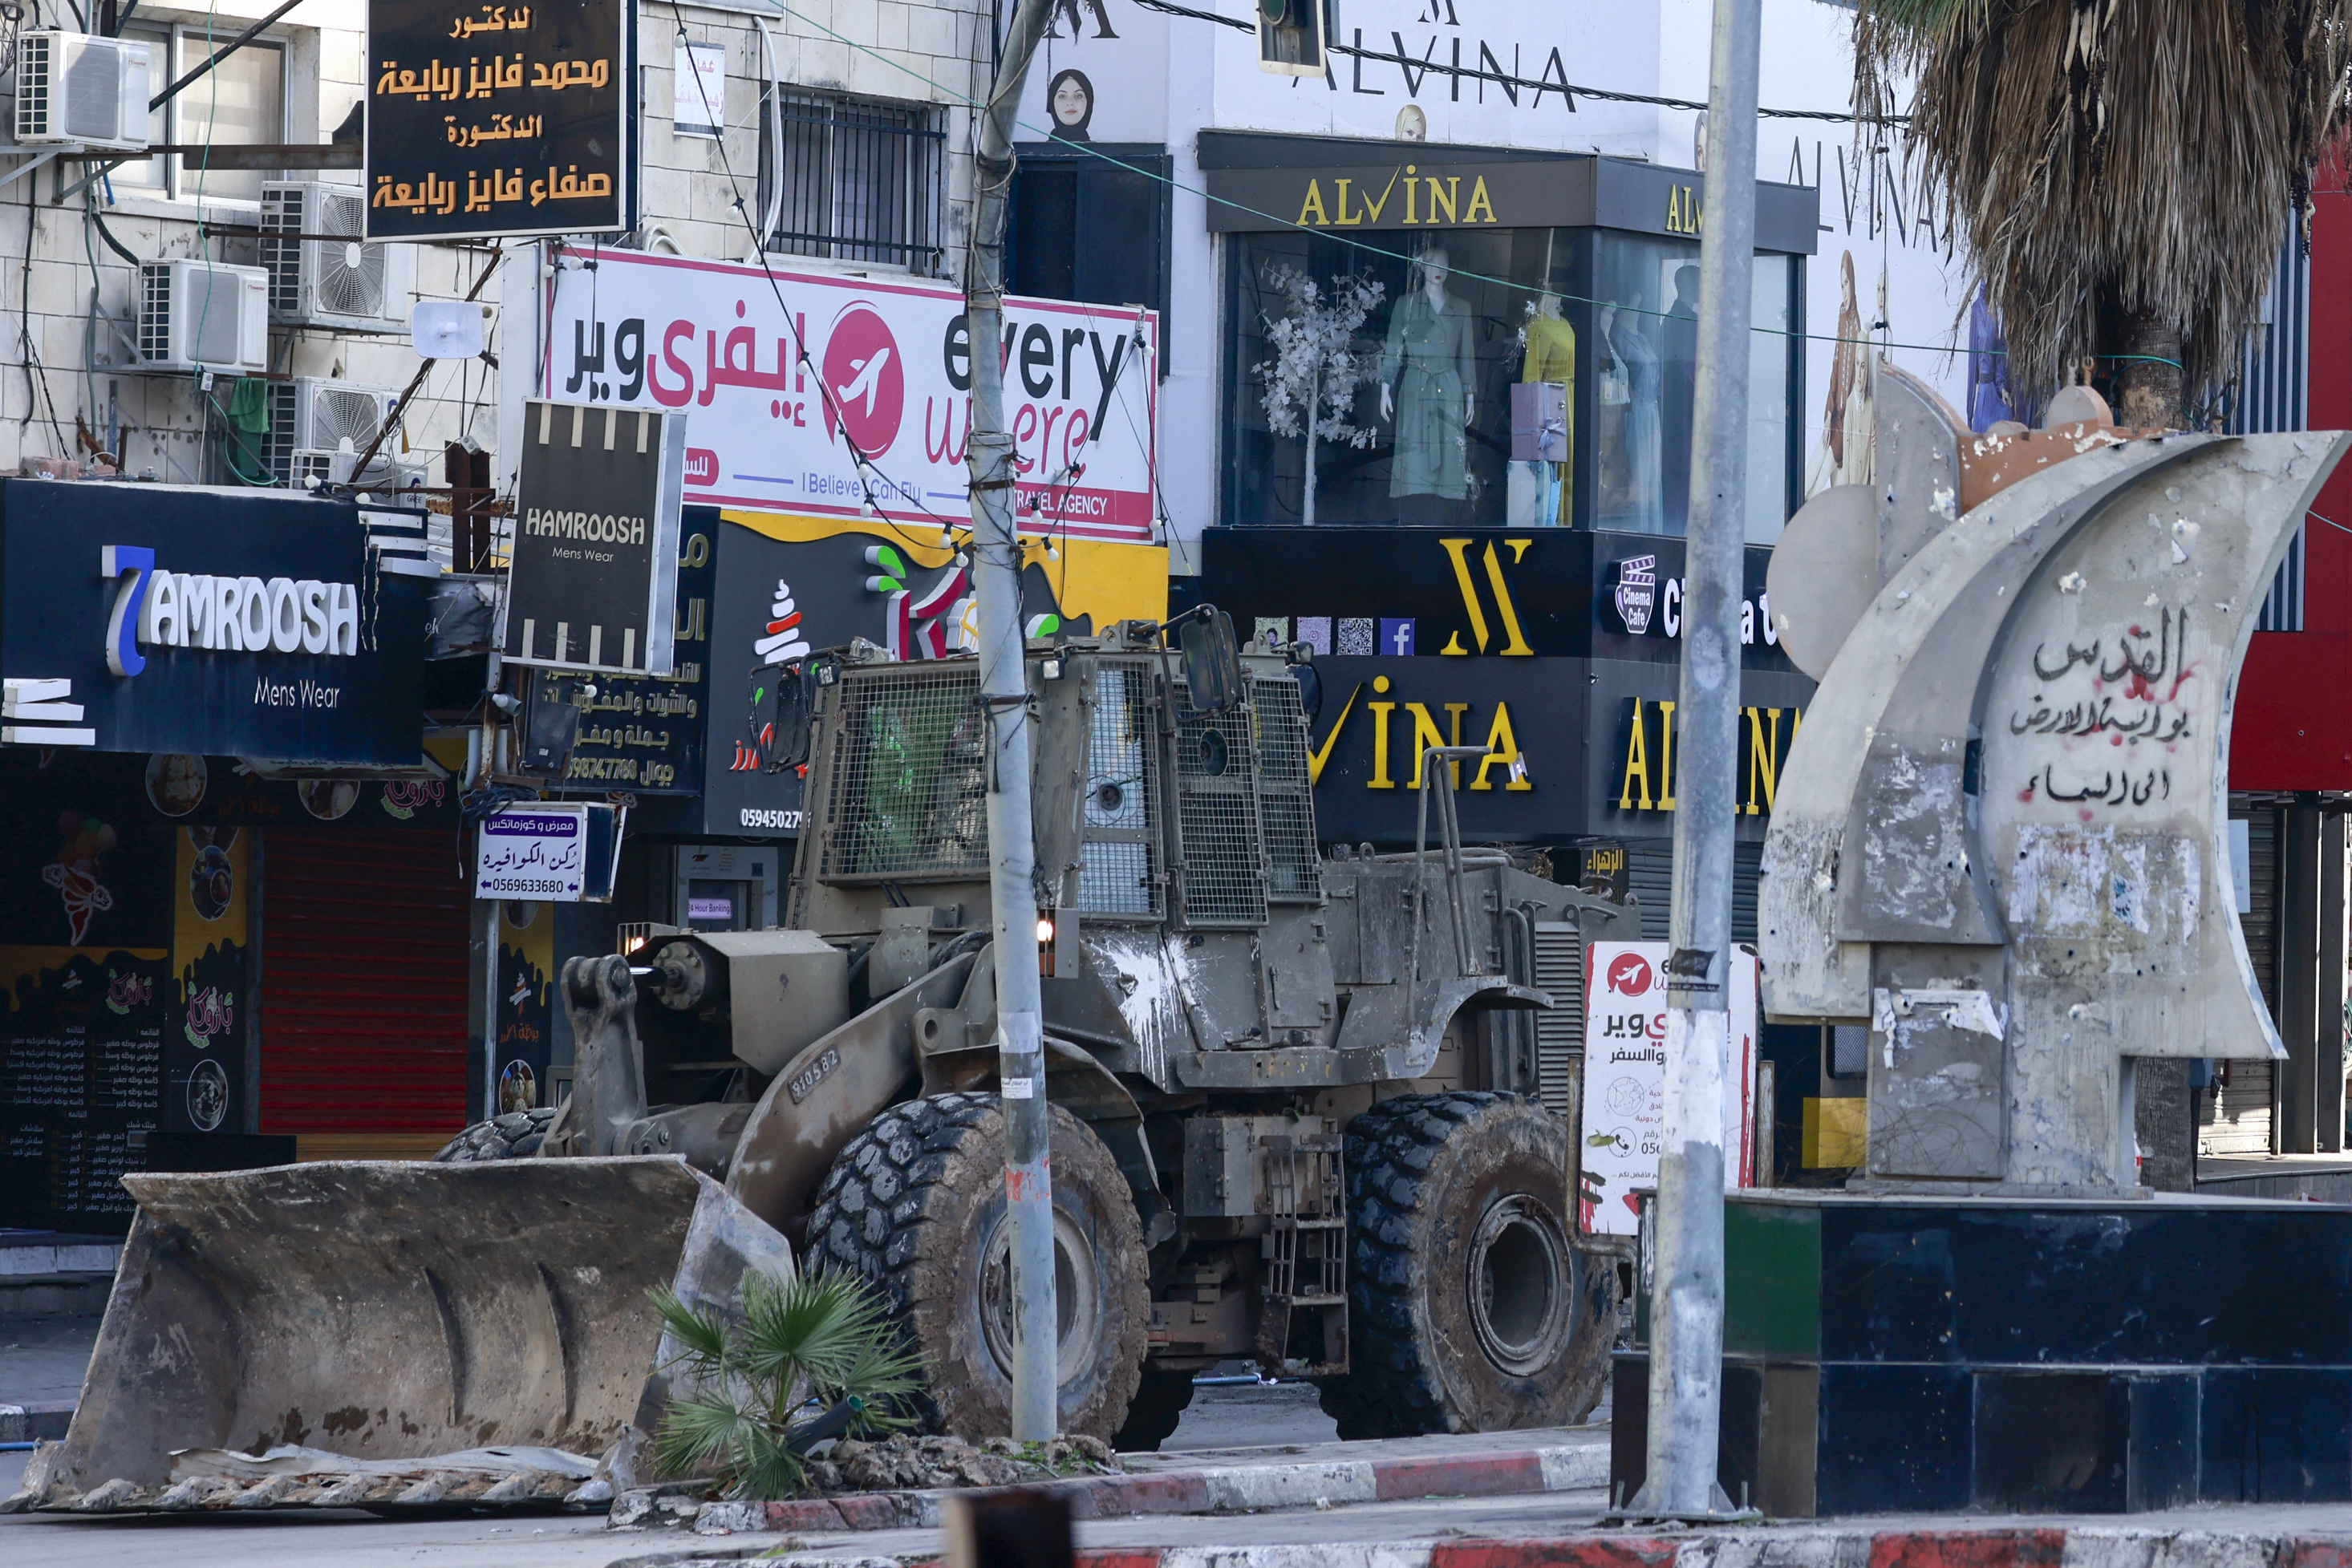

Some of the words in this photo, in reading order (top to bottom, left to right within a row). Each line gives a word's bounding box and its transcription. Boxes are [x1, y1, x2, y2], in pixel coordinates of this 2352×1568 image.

[375, 59, 462, 101] ربايعة
[465, 52, 525, 99] فايز
[530, 58, 610, 91] محمد
[444, 114, 543, 148] الدكتورة
[371, 172, 456, 215] ربايعة
[464, 168, 524, 213] فايز
[529, 164, 611, 208] صفاء
[1296, 164, 1498, 225] ALVINA
[809, 472, 860, 498] Believe
[870, 481, 898, 499] Can
[901, 482, 921, 502] Fly
[1057, 493, 1108, 517] AGENCY
[525, 508, 645, 545] HAMROOSH
[552, 546, 582, 560] Mens
[584, 549, 614, 562] Wear
[1623, 586, 1651, 607] Cinema
[1628, 607, 1645, 626] Cafe
[2034, 606, 2189, 684] القدس
[254, 676, 296, 707] Mens
[299, 679, 340, 709] Wear
[488, 819, 536, 831] كوزماتكس
[537, 823, 544, 832] و
[545, 821, 574, 833] معرض
[1587, 849, 1624, 877] الزهراء
[493, 878, 564, 893] 0569633680
[695, 904, 708, 913] Hour
[709, 904, 730, 914] Banking
[792, 1050, 837, 1098] 910582
